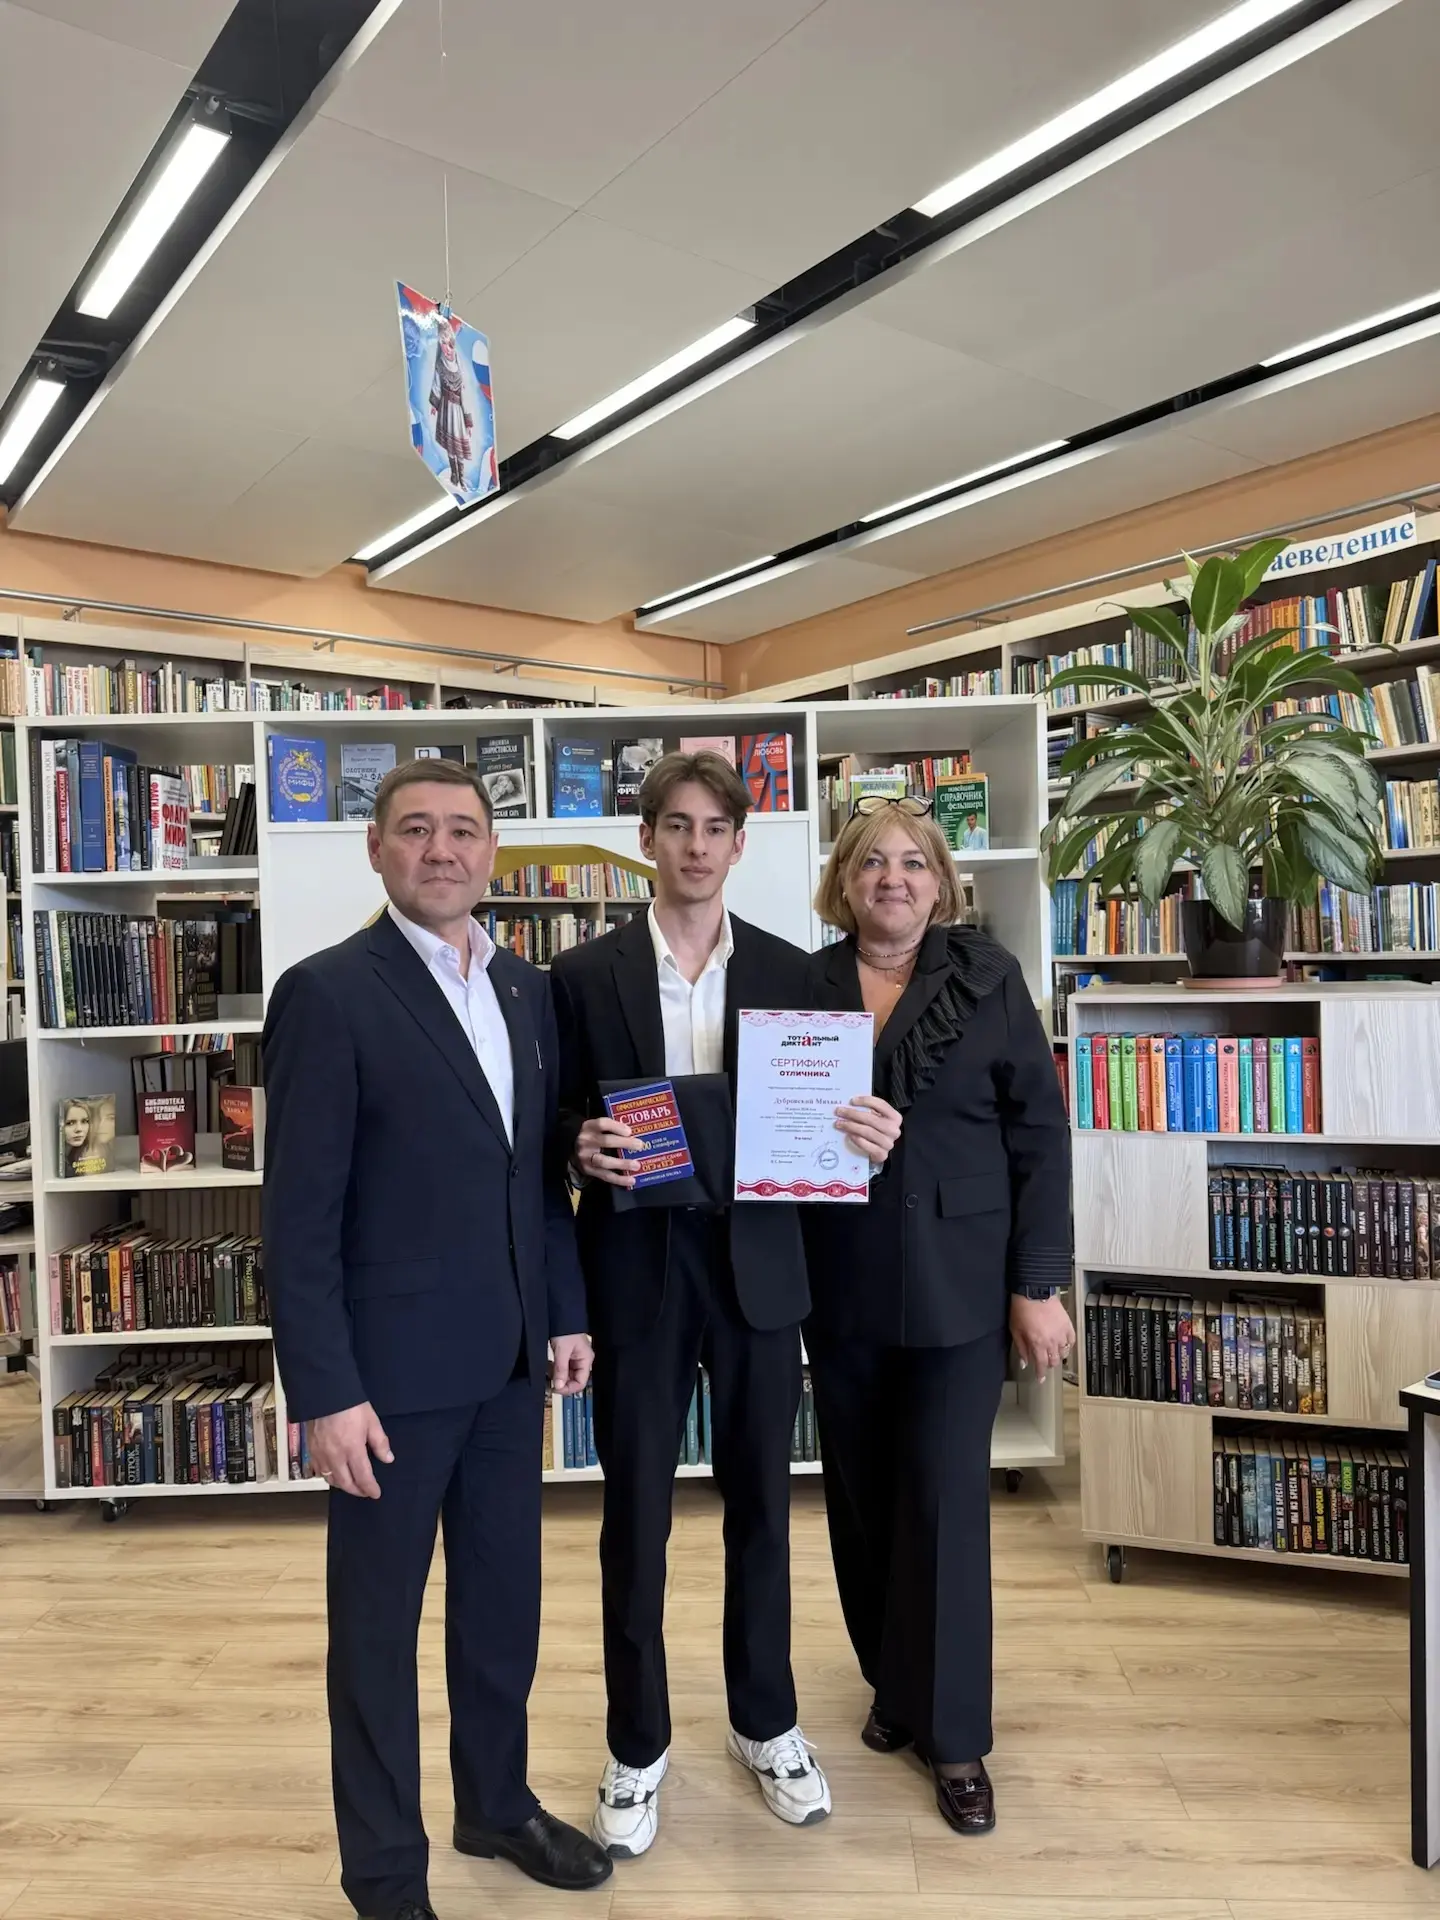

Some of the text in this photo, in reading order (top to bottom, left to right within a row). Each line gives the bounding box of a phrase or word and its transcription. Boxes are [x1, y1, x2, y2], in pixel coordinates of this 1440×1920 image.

[1271, 522, 1414, 572] аеведение
[753, 746, 785, 756] ЛЮБОВЬ
[288, 779, 316, 787] МИФЫ
[617, 787, 640, 795] ФРЕ
[948, 784, 975, 792] НОВЕЙШИЙ
[940, 791, 983, 803] СПРАВОЧНИК
[151, 782, 160, 830] ФЛАГИ МИРА
[162, 803, 189, 825] ФЛАГИ
[947, 801, 983, 811] фельдшера
[165, 824, 187, 847] МИРА
[61, 847, 69, 866] 1000
[770, 1058, 840, 1068] СЕРТИФИКАТ
[780, 1070, 830, 1078] отличника
[144, 1105, 185, 1114] ПОТЕРЯННЫХ
[145, 1097, 185, 1106] БИБЛИОТЕКА
[616, 1094, 668, 1111] ОРФОГРАФИЧЕСКИЙ
[773, 1097, 814, 1105] Дубровский
[154, 1112, 177, 1121] ВЕЩЕЙ
[620, 1105, 671, 1125] СЛОВАРЬ
[631, 1120, 674, 1134] СКОГО ЯЗЫКА
[643, 1163, 656, 1172] ОГЭ
[661, 1160, 674, 1168] ЕГЭ
[1358, 1211, 1367, 1235] ПАЛАЧ
[1113, 1328, 1122, 1360] ИСХОД
[1140, 1323, 1149, 1362] ОСТАЮСЬ
[1212, 1349, 1221, 1379] ВОРОН
[127, 1449, 137, 1483] ОТРОК
[1275, 1483, 1285, 1530] МЫ ИЗ БРЕСТА
[1288, 1477, 1299, 1524] МЫ ИЗ БРЕСТА
[1315, 1488, 1324, 1515] ФОРСАЖ!
